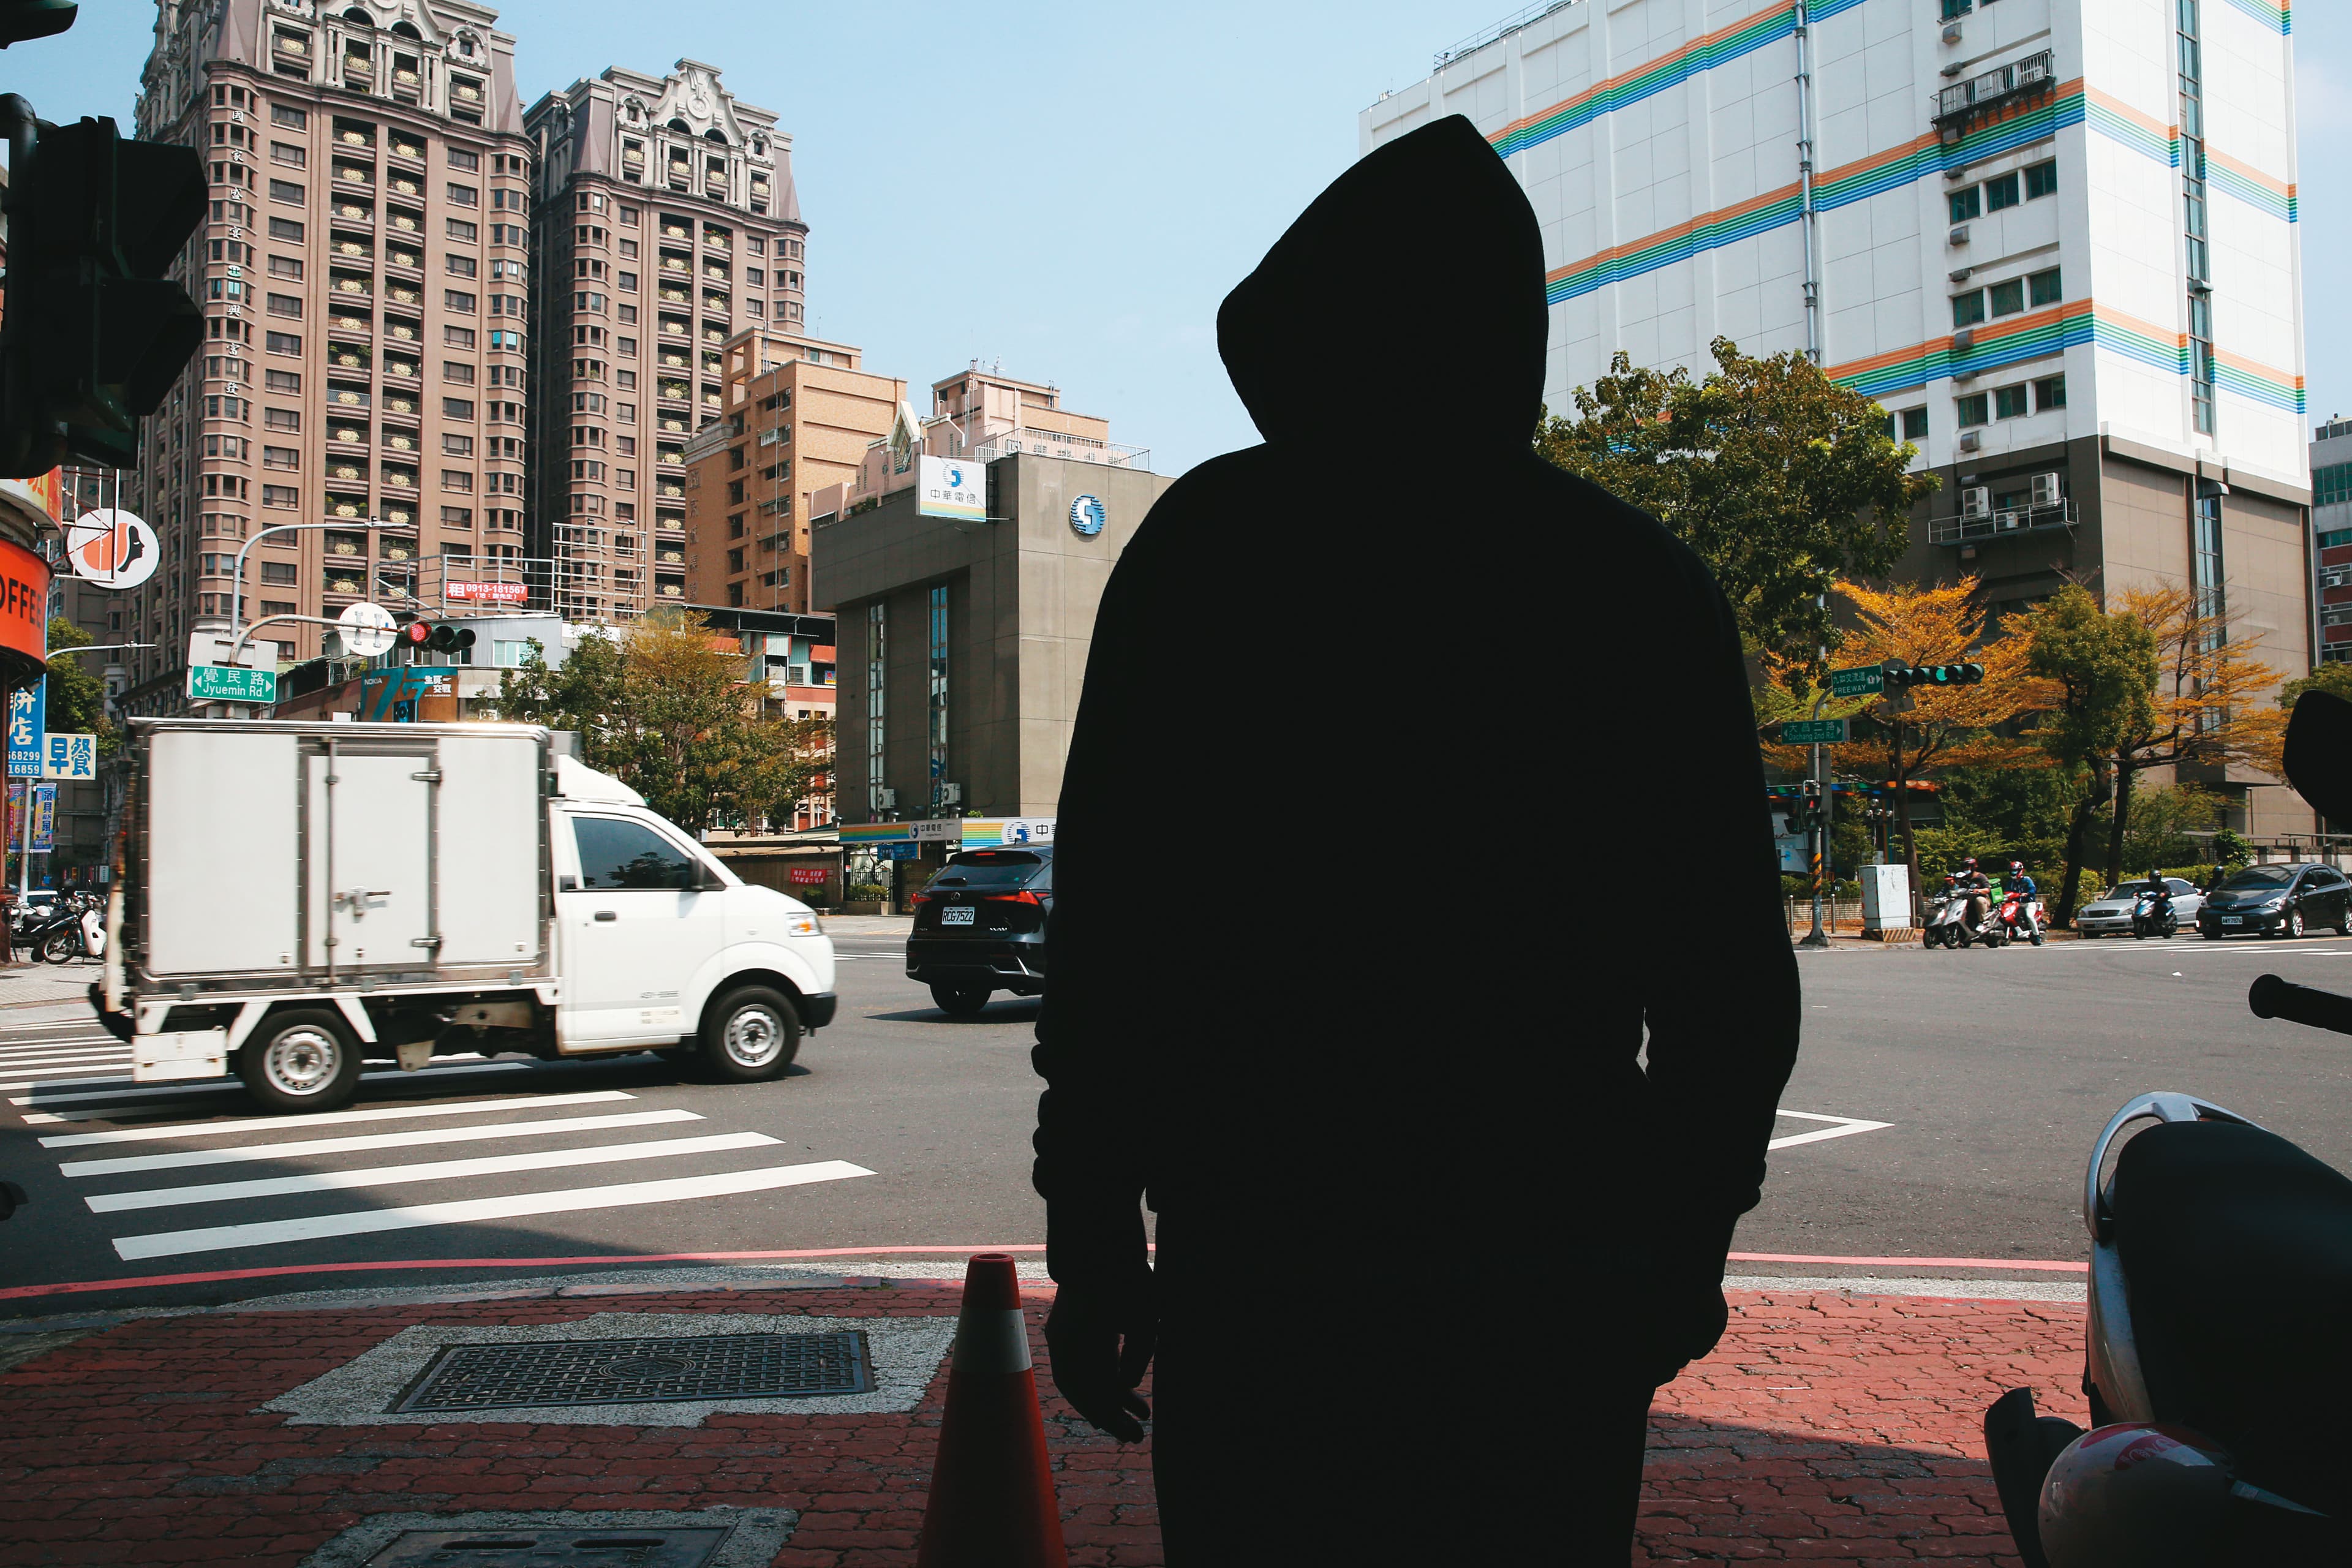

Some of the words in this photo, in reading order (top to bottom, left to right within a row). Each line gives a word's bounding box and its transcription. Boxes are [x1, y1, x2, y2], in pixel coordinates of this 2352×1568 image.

[225, 304, 241, 395] 興富發
[930, 489, 976, 504] 中華電信
[448, 583, 465, 597] 租
[466, 584, 526, 594] 0913-181567
[203, 668, 265, 685] 覺民路
[1833, 672, 1865, 684] 九如交流道
[203, 682, 246, 696] Jyuemin
[249, 685, 264, 697] Rd.
[1834, 684, 1866, 694] FREEWAY
[1789, 721, 1834, 733] 大昌二路
[1789, 733, 1813, 742] Dachang
[49, 737, 91, 776] 早餐
[943, 911, 973, 922] RCG-7522
